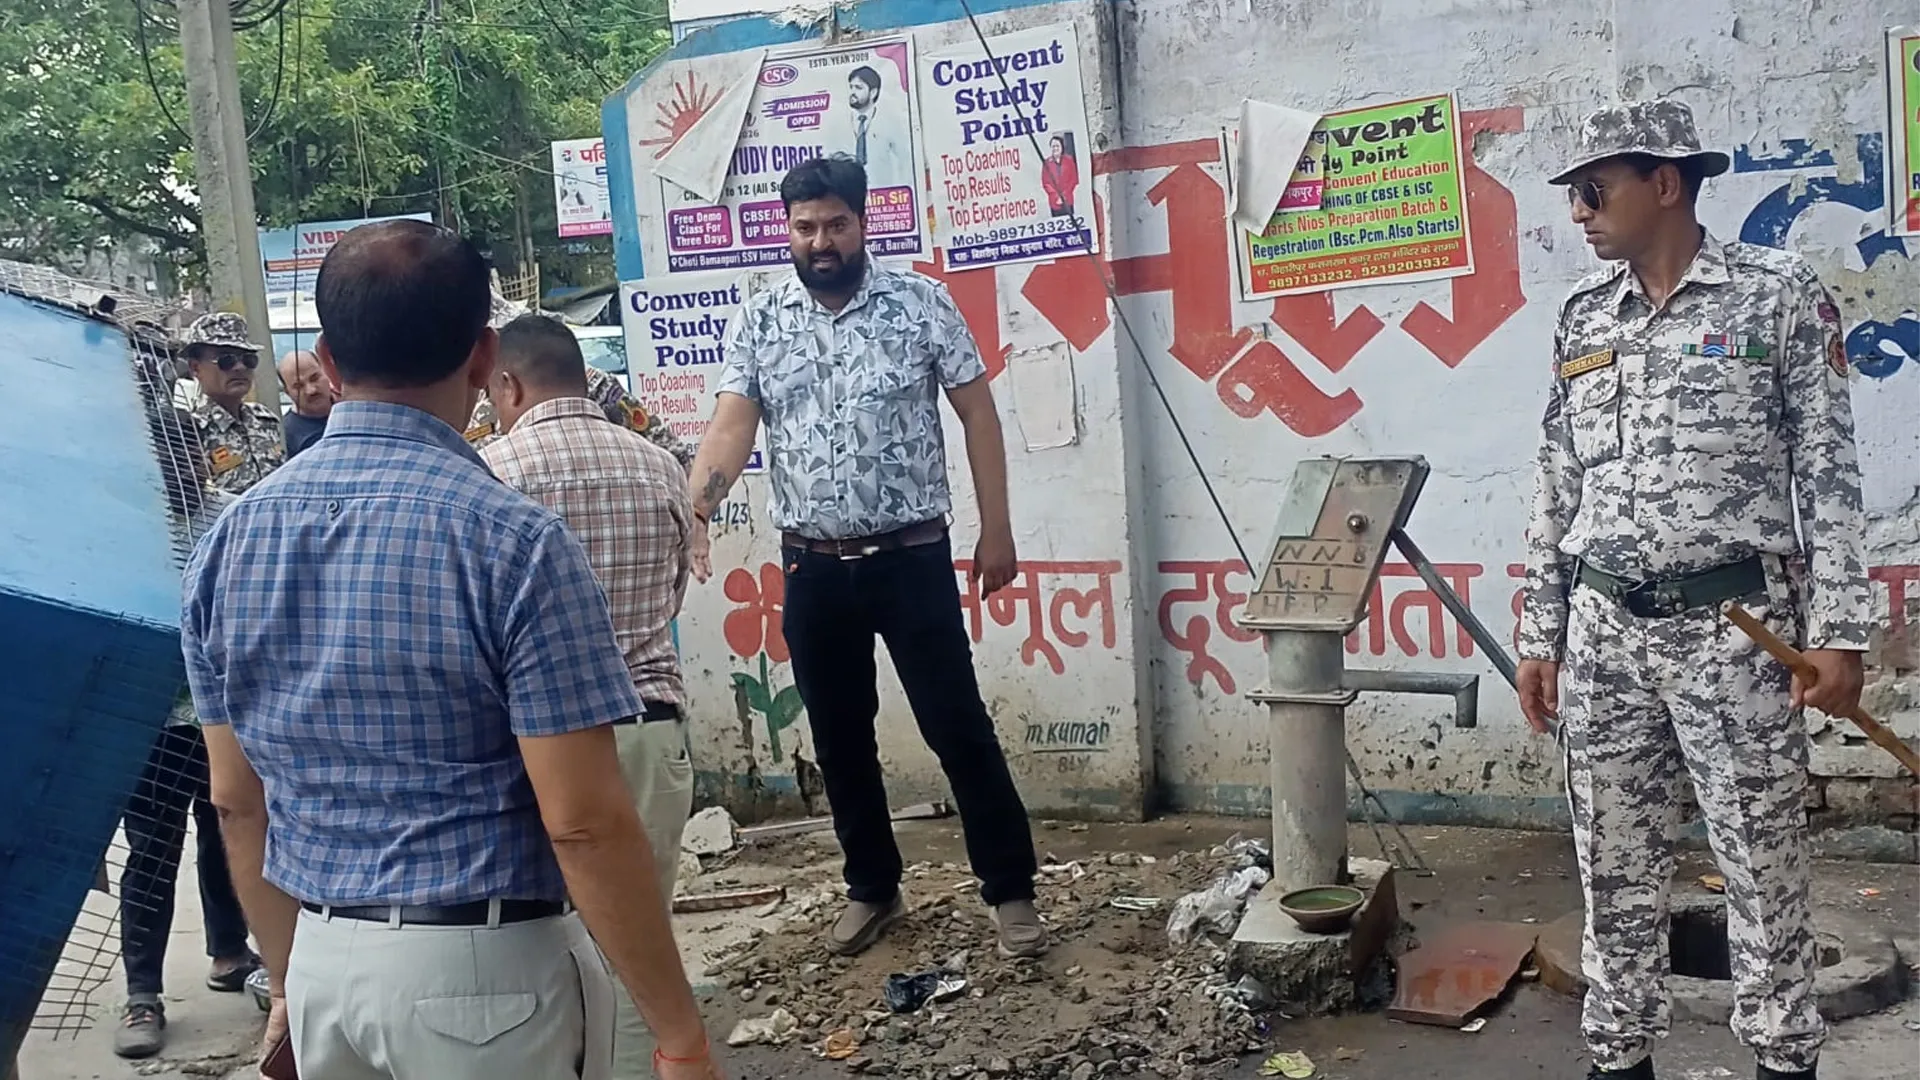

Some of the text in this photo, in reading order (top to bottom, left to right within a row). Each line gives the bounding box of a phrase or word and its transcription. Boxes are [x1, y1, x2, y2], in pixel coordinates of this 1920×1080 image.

[832, 54, 850, 67] YEAR
[932, 39, 1065, 87] Convent
[763, 67, 790, 85] CSC
[777, 98, 828, 112] ADMISSION
[954, 77, 1048, 115] Study
[791, 115, 816, 126] OPEN
[960, 108, 1048, 146] Point
[1327, 103, 1446, 148] vent
[727, 145, 767, 176] TUDY
[941, 145, 1020, 180] Top Coaching
[1350, 143, 1409, 168] Point
[1323, 160, 1450, 190] Convent Education
[725, 186, 735, 197] to
[738, 184, 750, 196] 12
[889, 190, 909, 204] Sir
[944, 172, 1012, 206] Top Results
[1322, 181, 1434, 210] HING OF CBSE & ISC
[673, 211, 722, 225] Free Demo
[743, 208, 787, 223] CBSE/IC
[947, 197, 1037, 231] Top Experience
[1264, 195, 1449, 237] tarts Nios Preparation Batch &
[676, 234, 728, 247] Three Days
[679, 223, 721, 235] Class For
[745, 226, 760, 238] UP
[952, 216, 1085, 247] Mob-9897133232
[1252, 236, 1325, 260] Regestration
[1417, 214, 1460, 236] Starts)
[742, 251, 758, 263] SSV
[760, 250, 778, 261] Inter
[886, 238, 919, 252] Bareilly
[1361, 255, 1450, 277] 9219203932
[631, 283, 742, 314] Convent
[650, 313, 728, 341] Study
[655, 343, 726, 368] Point
[638, 370, 705, 398] Top Coaching
[661, 393, 698, 415] Results
